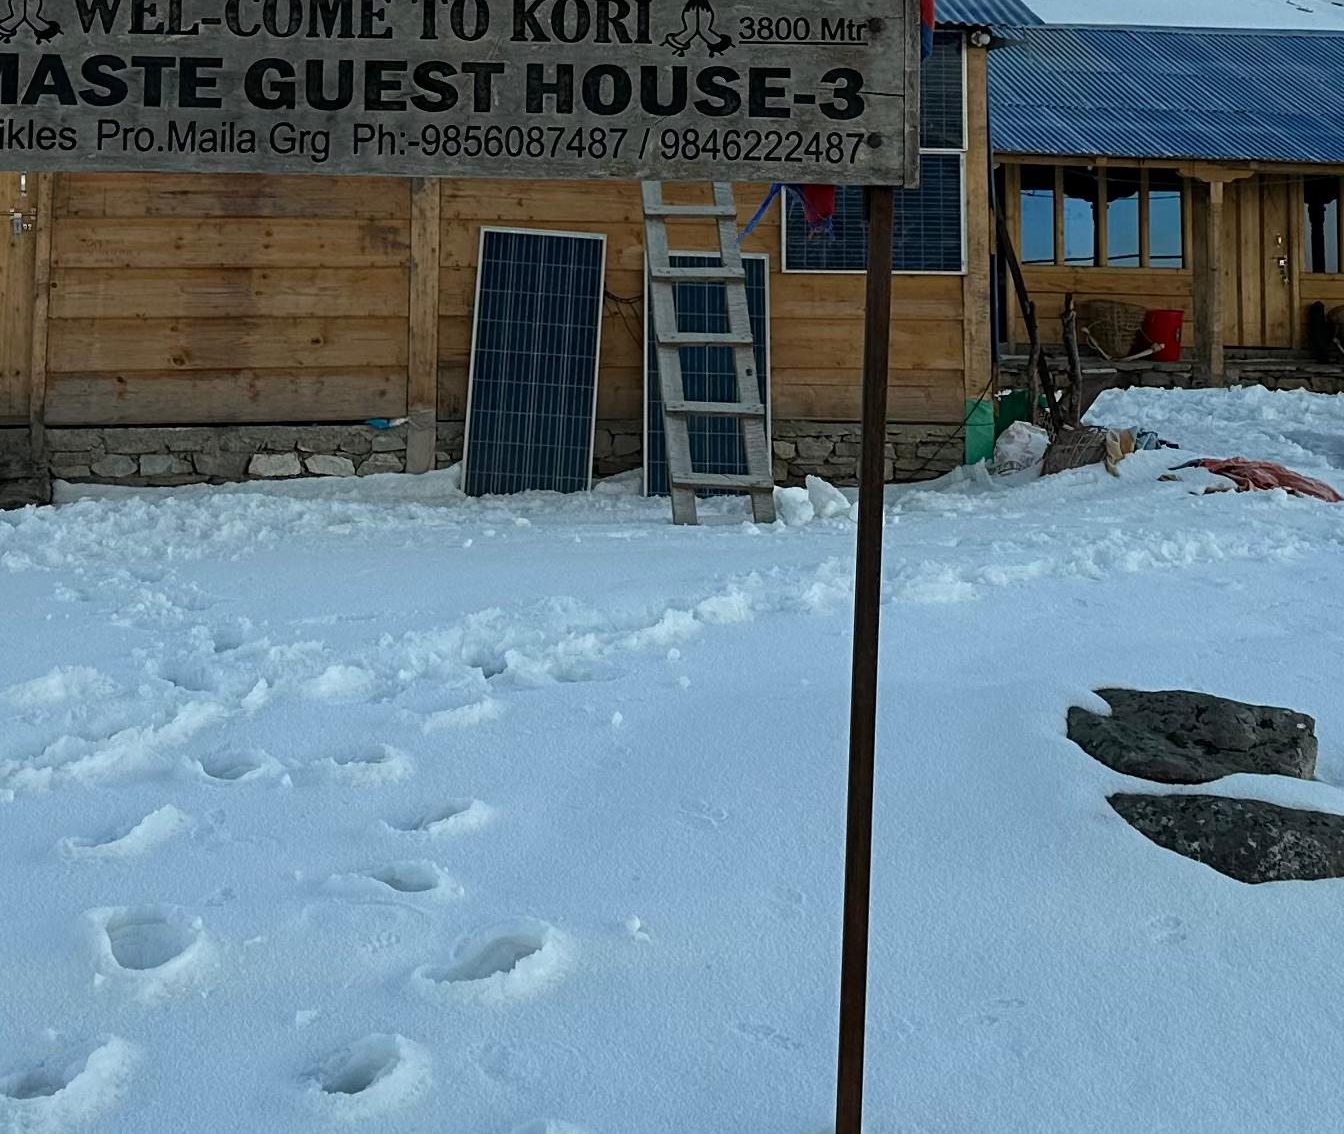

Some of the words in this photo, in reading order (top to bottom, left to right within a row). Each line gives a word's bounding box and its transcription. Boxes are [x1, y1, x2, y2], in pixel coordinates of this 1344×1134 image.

[739, 17, 810, 40] 3800
[821, 18, 868, 41] Mtr
[244, 58, 505, 113] GUEST
[526, 64, 865, 120] HOUSE-3
[97, 120, 256, 154] Pro.Maila
[270, 123, 331, 162] Grg
[354, 123, 627, 159] Ph:-9856087487
[637, 128, 649, 160] /
[660, 129, 864, 164] 9846222487
